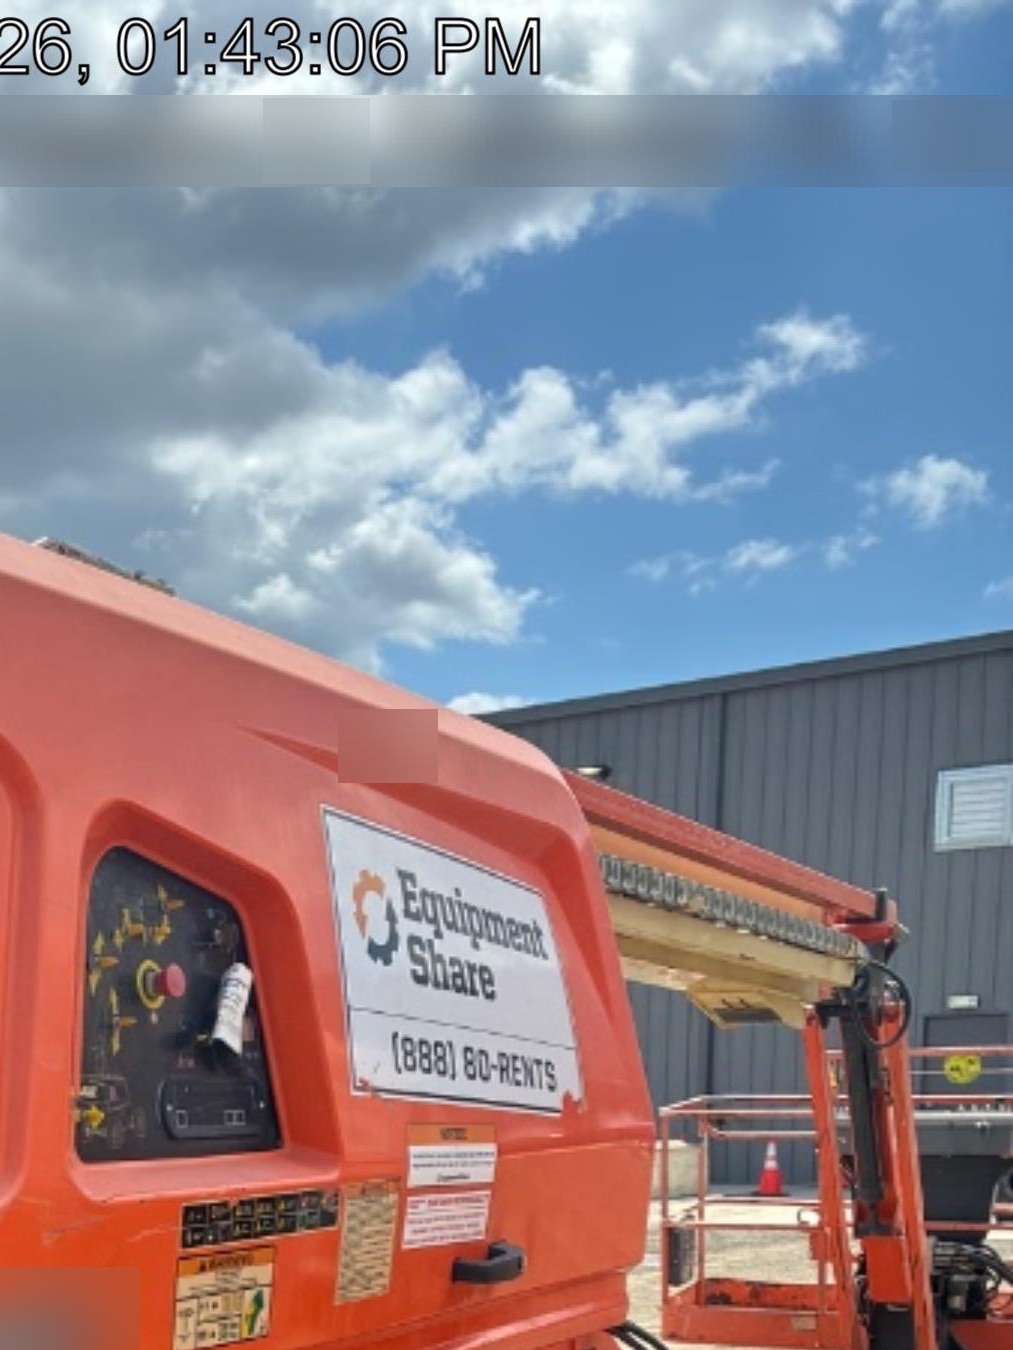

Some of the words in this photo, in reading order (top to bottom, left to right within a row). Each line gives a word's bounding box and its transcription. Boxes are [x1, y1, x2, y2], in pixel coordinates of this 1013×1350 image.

[397, 869, 548, 960] Equipment
[406, 935, 496, 1001] Share
[391, 1031, 456, 1080] (888)
[463, 1046, 557, 1092] 80-RENTS
